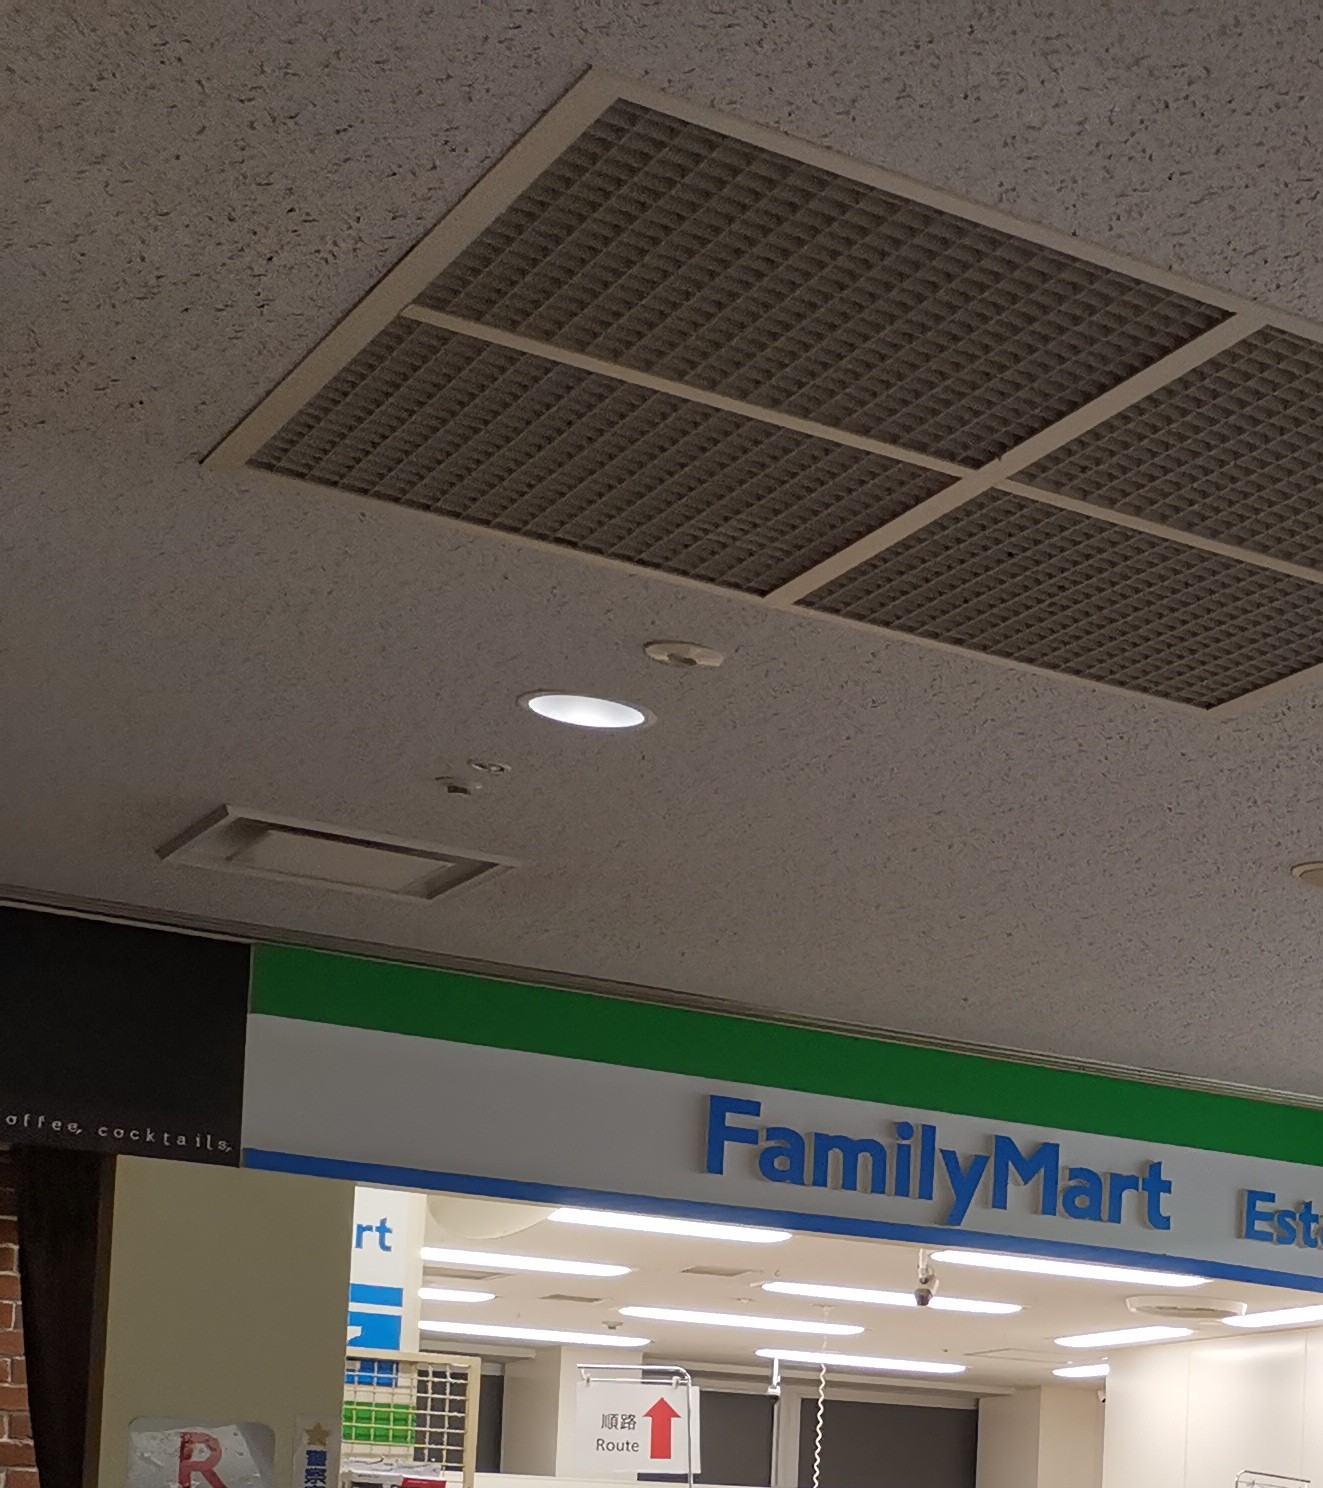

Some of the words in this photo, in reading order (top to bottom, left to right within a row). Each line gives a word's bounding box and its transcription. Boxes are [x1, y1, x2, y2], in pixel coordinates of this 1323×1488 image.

[97, 1127, 233, 1153] cocktails,
[705, 1094, 1173, 1231] FamilyMart
[600, 1412, 637, 1432] 順路
[595, 1438, 640, 1453] Route
